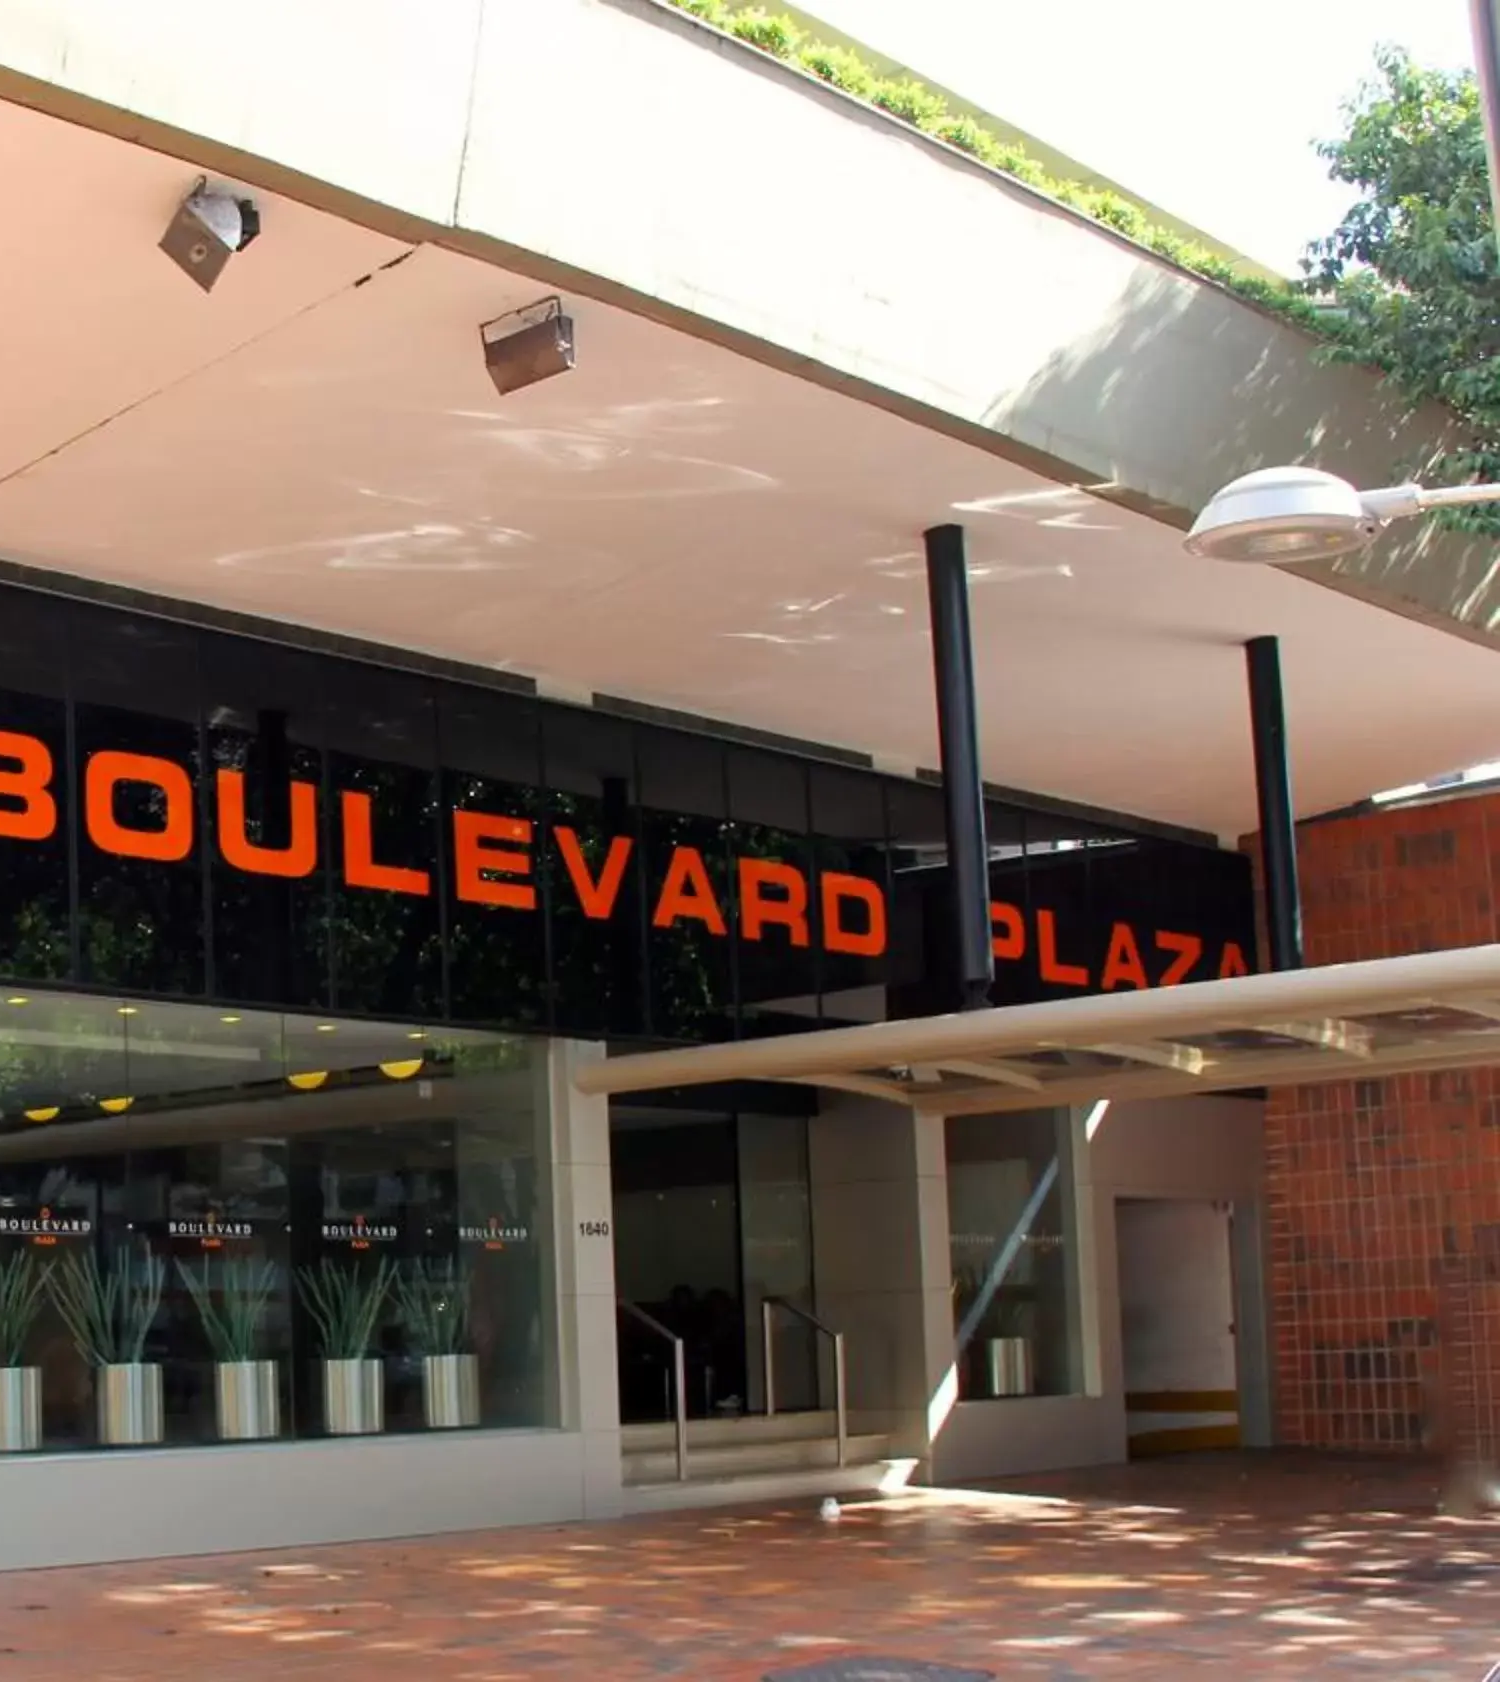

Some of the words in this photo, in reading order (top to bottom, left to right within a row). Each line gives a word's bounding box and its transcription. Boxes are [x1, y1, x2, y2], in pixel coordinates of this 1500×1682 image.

[0, 1217, 91, 1232] BOULEVARD
[169, 1221, 252, 1236] BOULEVARD
[580, 1221, 609, 1237] 1640
